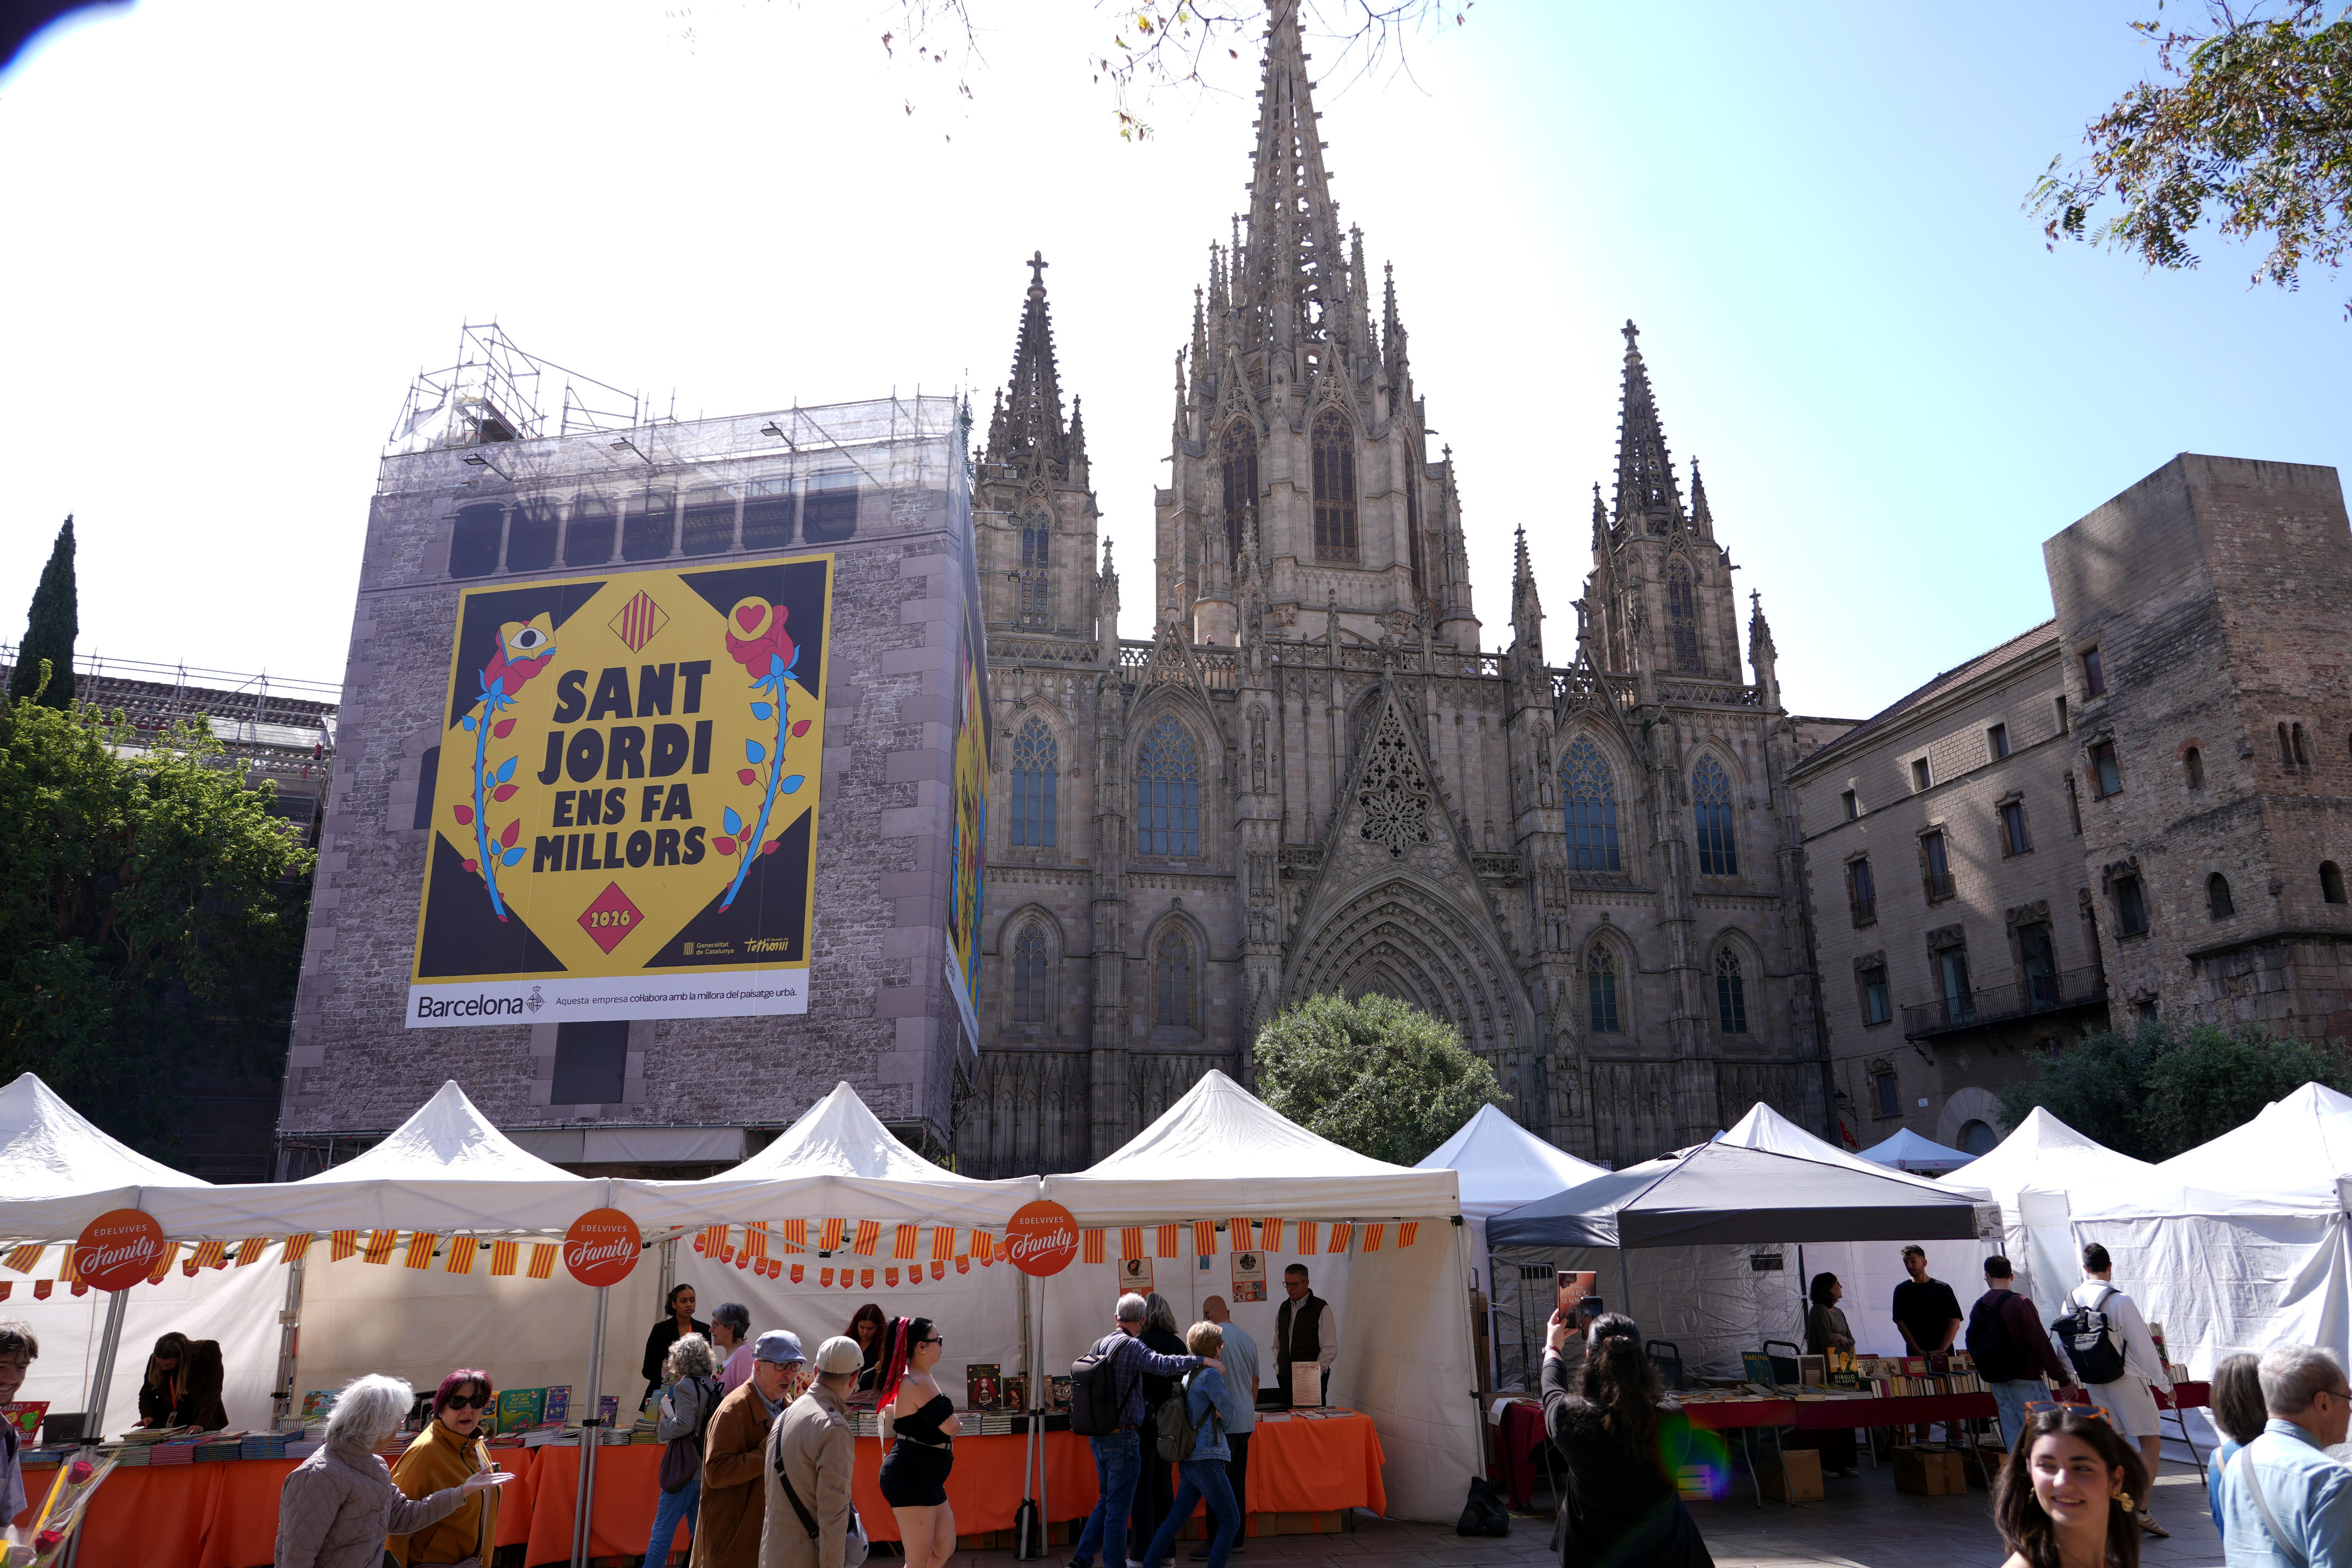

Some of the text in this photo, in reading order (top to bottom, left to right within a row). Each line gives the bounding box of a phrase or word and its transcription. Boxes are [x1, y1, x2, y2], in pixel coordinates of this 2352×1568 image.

[552, 660, 711, 723] SANT
[537, 720, 713, 785] JORDI
[552, 783, 693, 827] ENS FA
[532, 826, 706, 873] MILLORS
[590, 908, 631, 929] 2026
[417, 994, 524, 1018] Barcelona
[556, 997, 589, 1006] Aquesta
[592, 995, 628, 1005] empresa
[669, 992, 688, 1001] amb
[689, 992, 696, 1000] la
[697, 990, 725, 1000] millora
[726, 990, 739, 999] del
[740, 989, 774, 1000] paisatge
[776, 988, 797, 997] urbà.
[94, 1224, 148, 1237] EDELVIVES
[1020, 1216, 1064, 1224] EDELVIVES
[75, 1235, 164, 1274] Family
[564, 1236, 640, 1267] Family
[1005, 1227, 1079, 1259] Family
